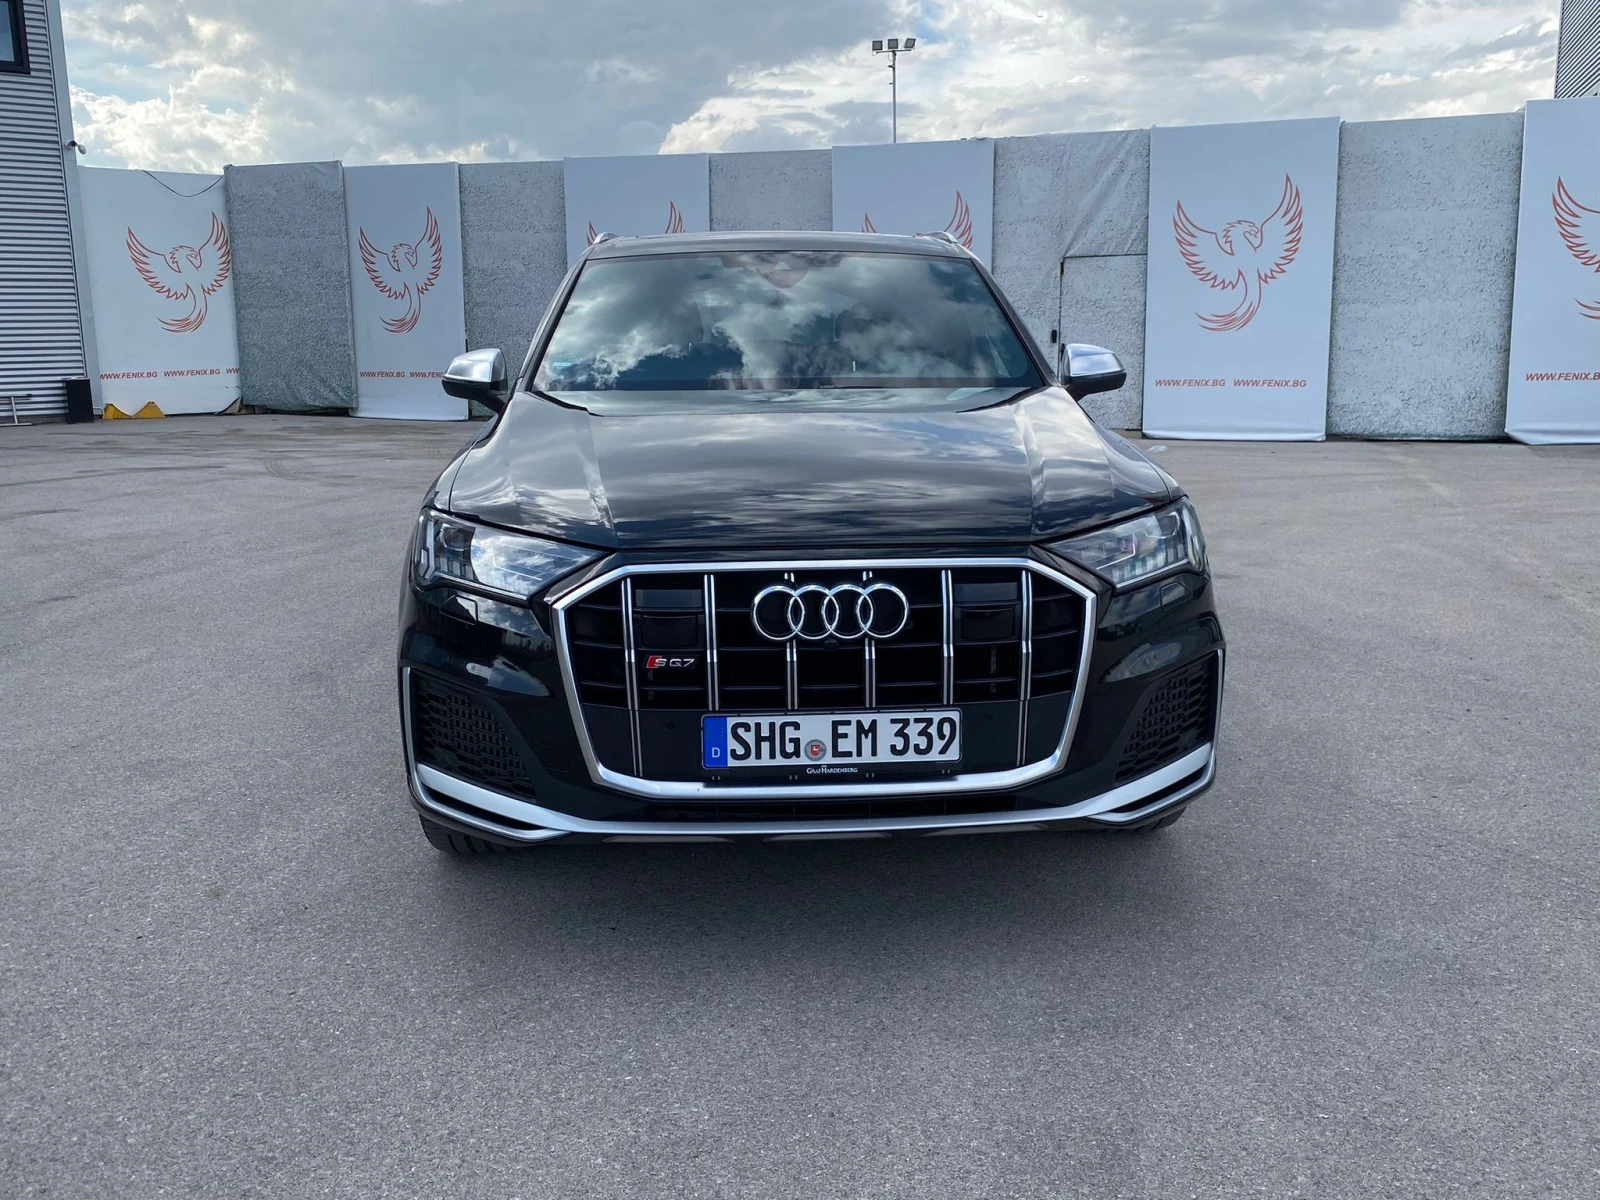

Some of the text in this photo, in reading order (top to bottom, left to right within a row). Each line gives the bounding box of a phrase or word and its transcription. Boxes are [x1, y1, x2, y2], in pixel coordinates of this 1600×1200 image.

[100, 371, 158, 380] WWW.FENIX.BG
[163, 368, 221, 377] WWW.FENIX.BG
[1155, 379, 1307, 388] WWW.FENIX.BG WWW.FENIX.BG
[646, 655, 695, 668] SQ7
[730, 716, 957, 761] SHG EM 339
[711, 747, 720, 758] D
